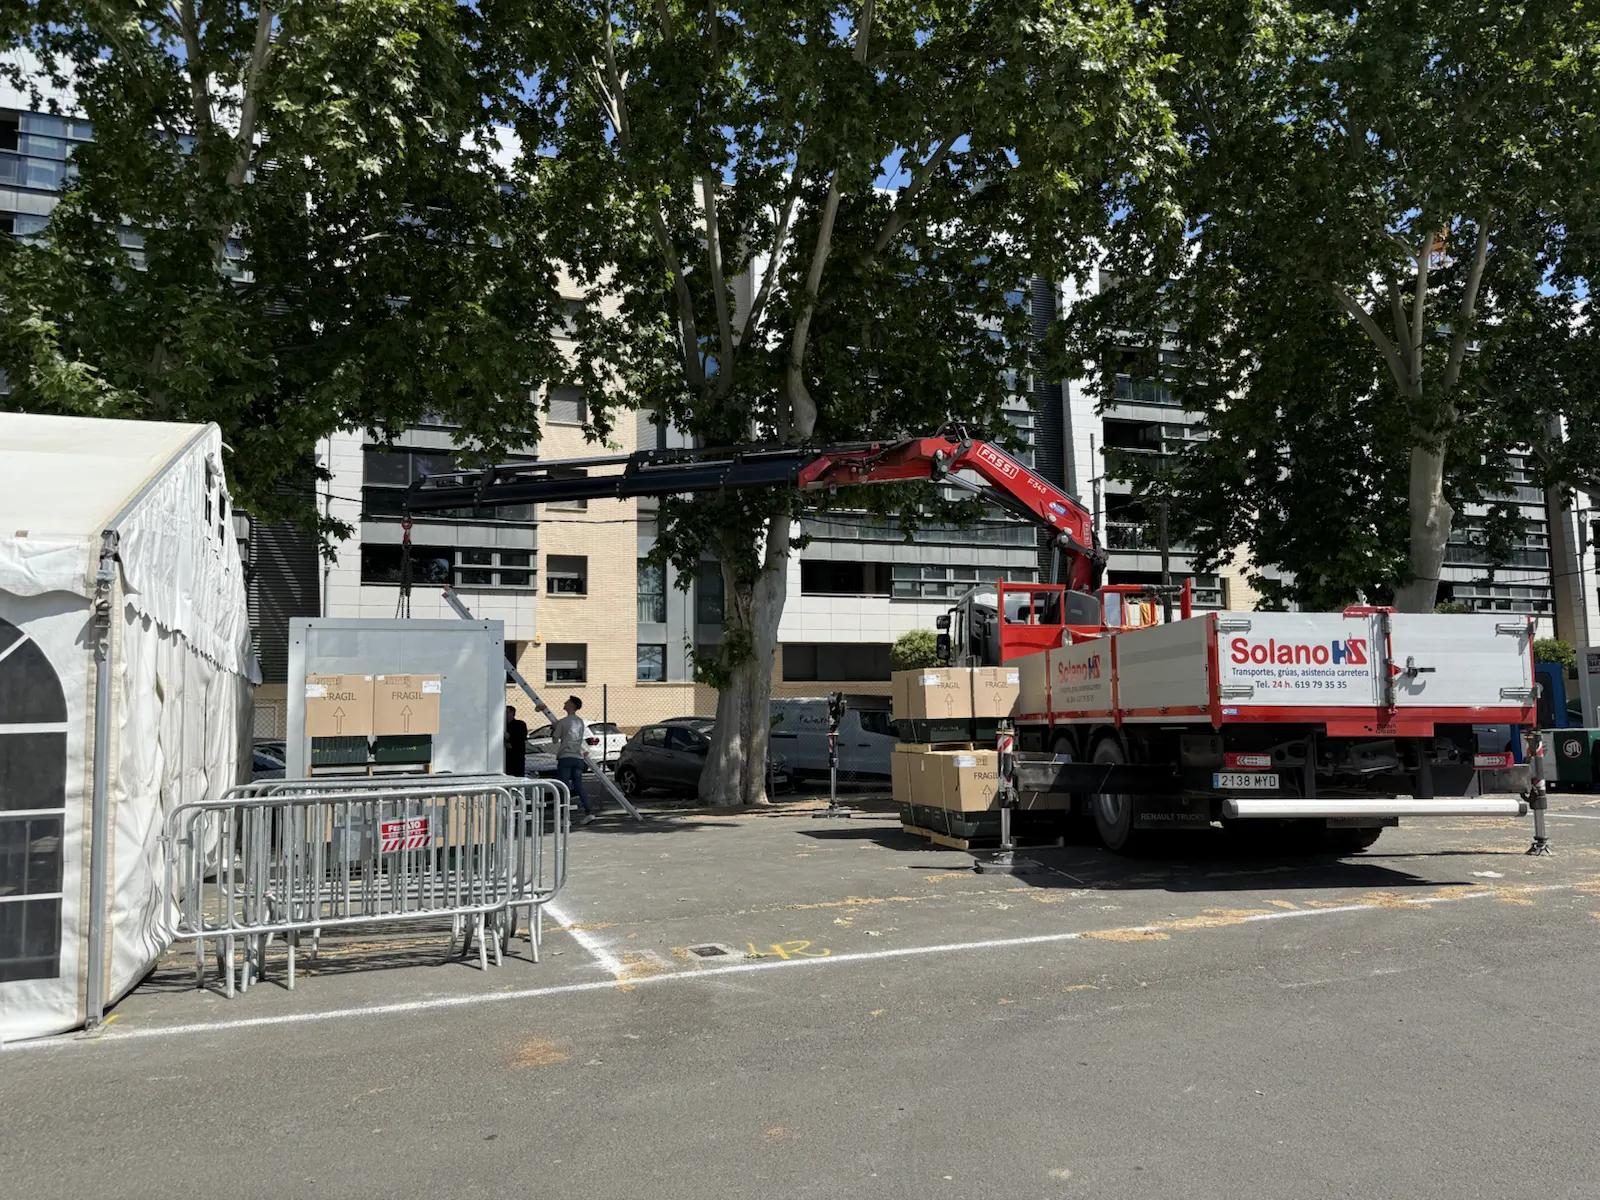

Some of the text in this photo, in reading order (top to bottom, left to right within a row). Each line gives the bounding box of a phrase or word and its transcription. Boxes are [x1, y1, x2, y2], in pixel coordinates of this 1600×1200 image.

[981, 448, 1015, 476] FASSI
[1231, 638, 1329, 664] Solano
[1231, 667, 1369, 678] Transportes, grúas, asistencia carretera
[938, 681, 960, 689] FRAGIL
[985, 681, 1008, 689] FRAGIL
[1255, 681, 1270, 689] Tel.
[1272, 681, 1282, 689] 24
[1295, 681, 1310, 689] 619
[1312, 681, 1323, 689] 79
[1325, 681, 1335, 689] 35
[1337, 681, 1347, 689] 35
[324, 692, 357, 701] FRAGIL
[391, 691, 424, 700] FRAGIL
[1221, 775, 1276, 787] 2138 MYD
[1140, 813, 1205, 821] RENAULT TRUCKS
